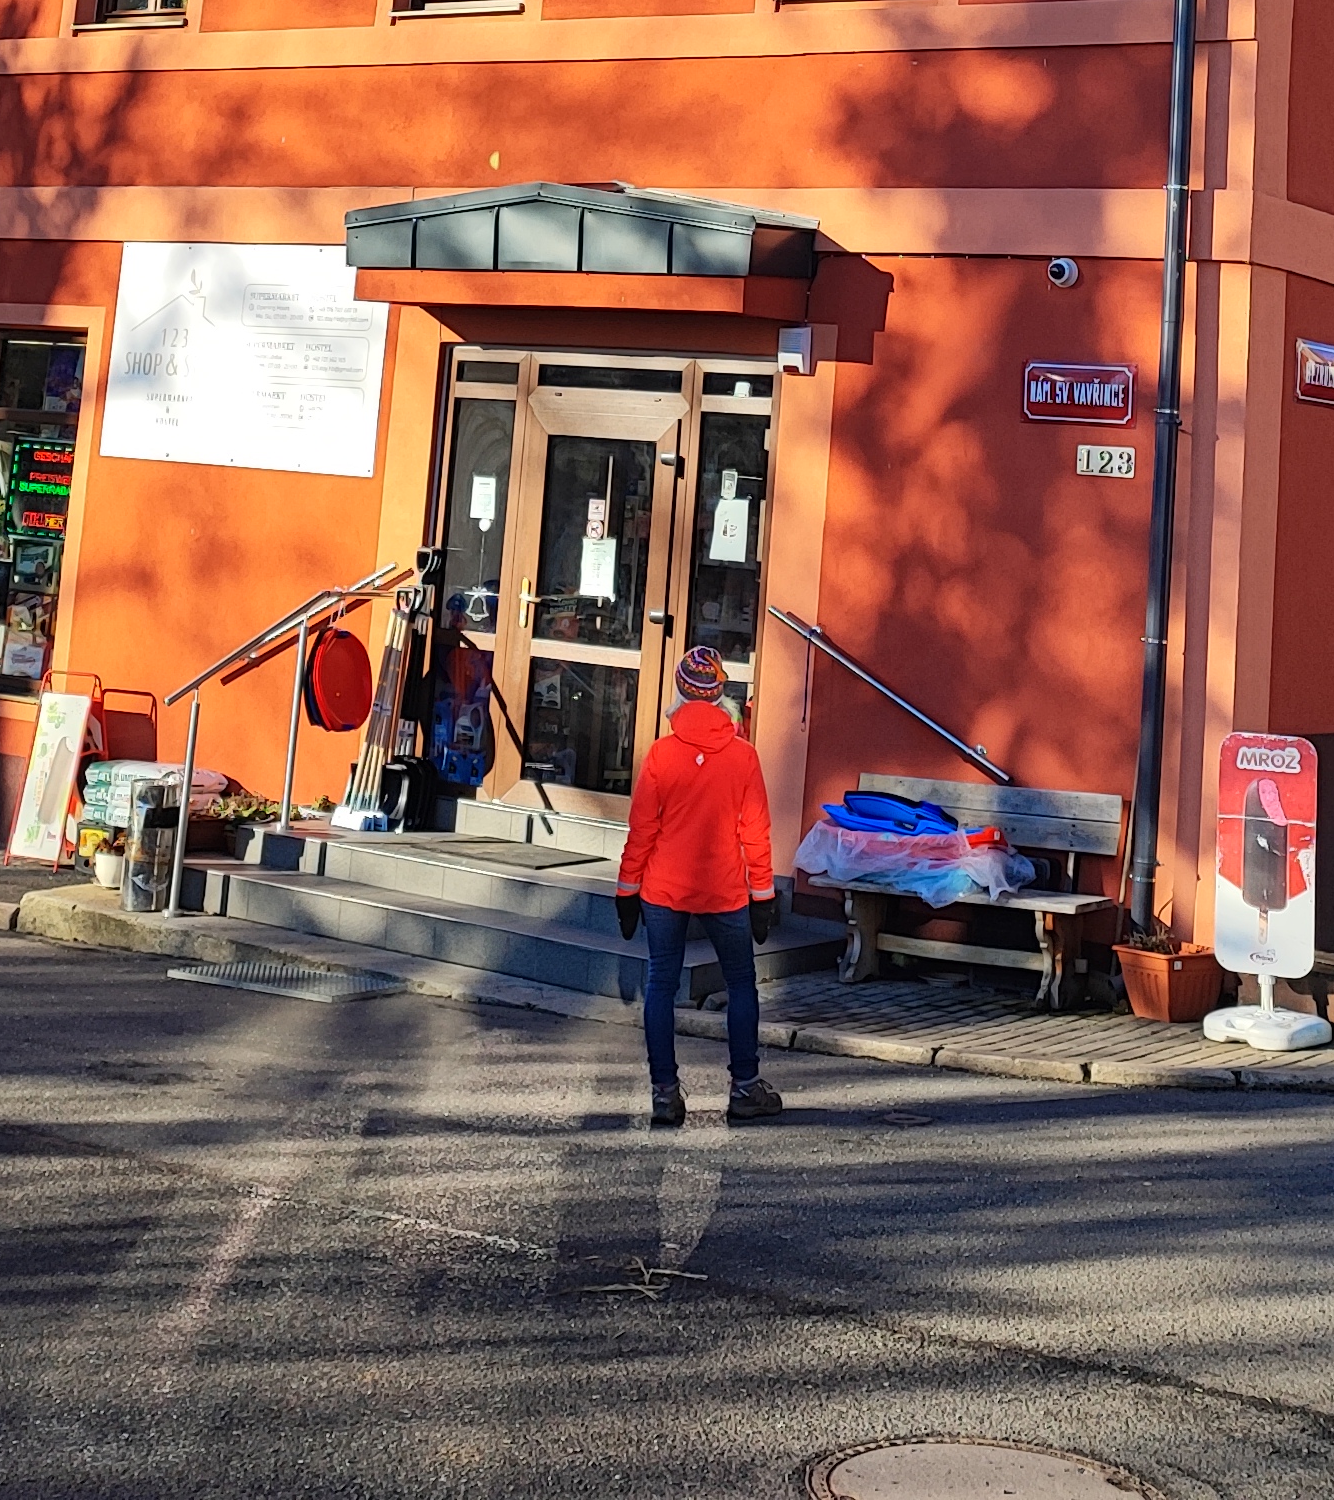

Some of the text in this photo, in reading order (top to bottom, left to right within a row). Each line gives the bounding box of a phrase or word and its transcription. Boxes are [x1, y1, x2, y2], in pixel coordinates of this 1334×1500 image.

[161, 328, 189, 348] 123
[246, 341, 296, 351] PERMARKET
[305, 343, 333, 352] HOSTEL
[124, 351, 163, 376] SHOP
[165, 353, 178, 376] &
[1073, 378, 1125, 408] VAVŘINCE
[1080, 448, 1133, 475] 123
